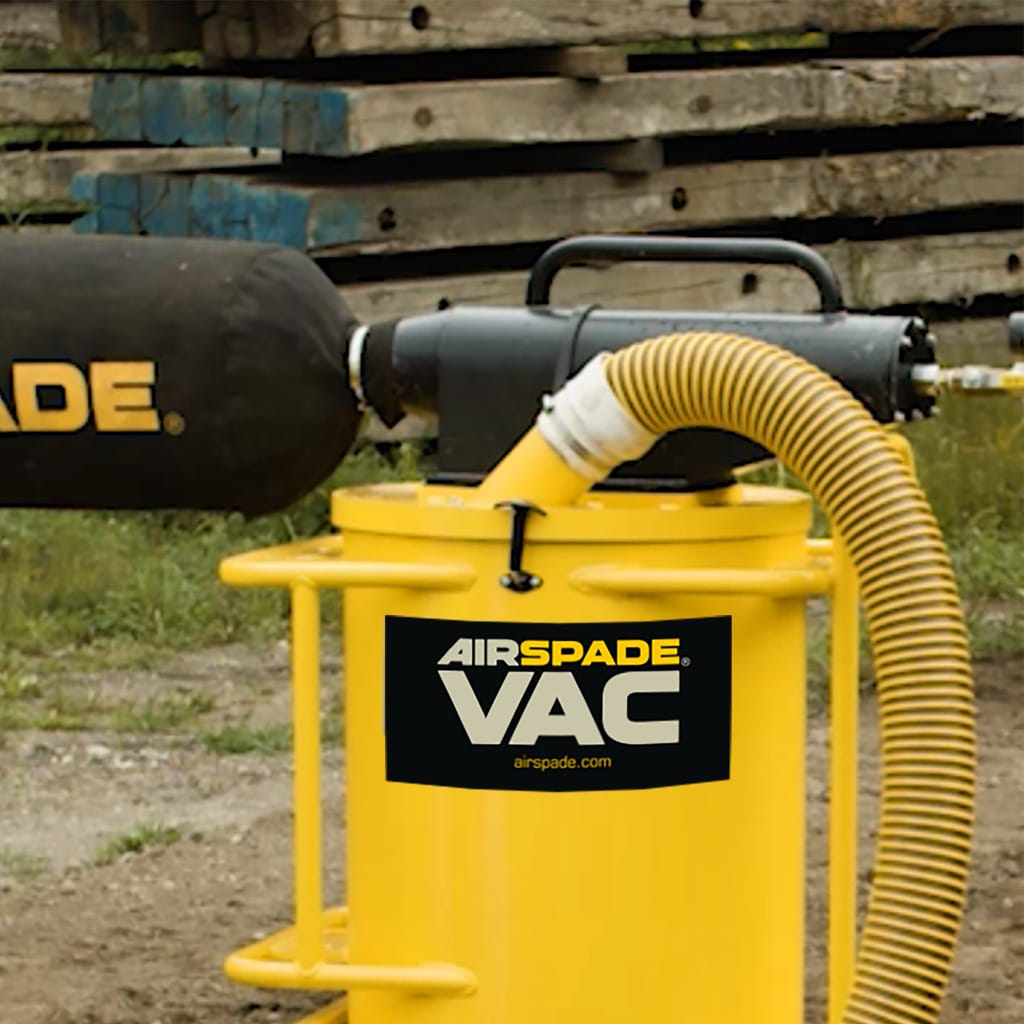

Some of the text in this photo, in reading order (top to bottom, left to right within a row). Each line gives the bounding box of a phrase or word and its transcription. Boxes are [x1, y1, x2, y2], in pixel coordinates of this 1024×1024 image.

[437, 638, 680, 666] AIRSPADE
[437, 670, 680, 745] VAC
[513, 756, 612, 771] airspade.com
